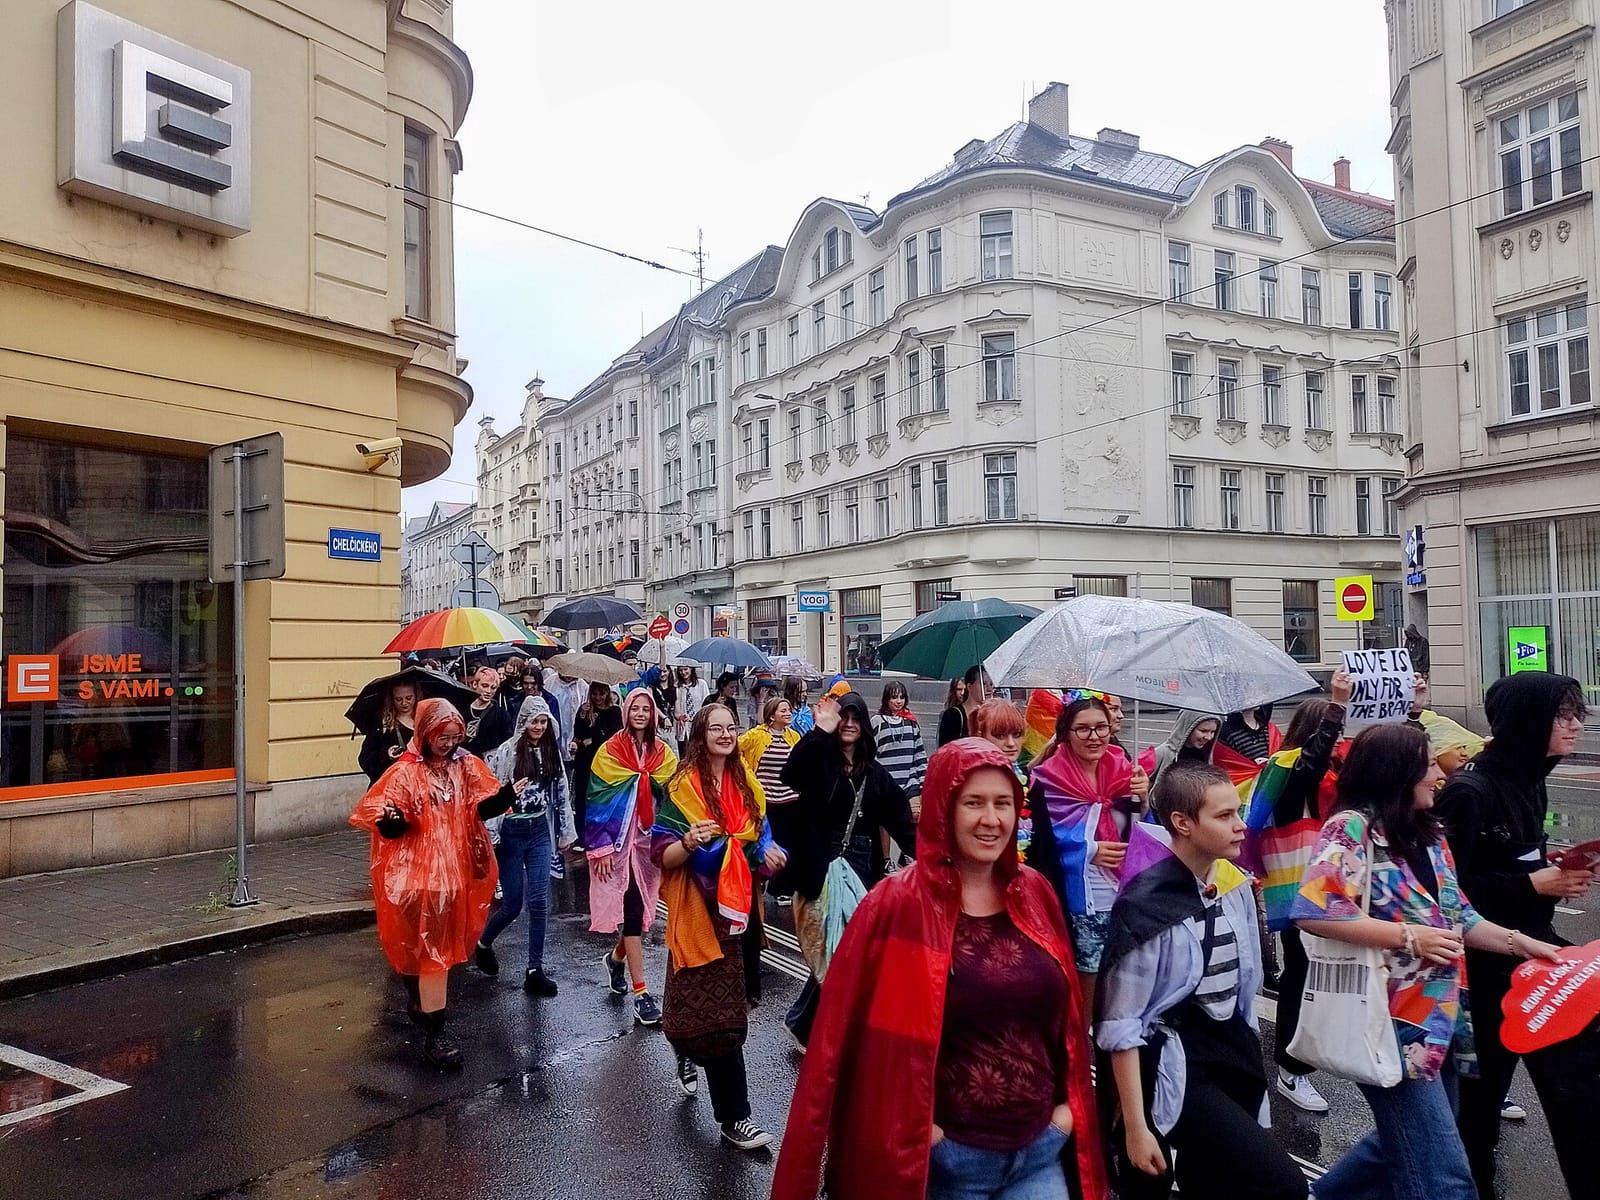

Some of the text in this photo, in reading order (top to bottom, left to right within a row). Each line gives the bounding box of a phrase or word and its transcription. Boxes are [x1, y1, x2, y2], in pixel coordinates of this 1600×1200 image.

[332, 535, 378, 554] CHELČICKÉHO
[677, 606, 687, 615] 30
[79, 654, 142, 673] JSME
[1345, 650, 1408, 674] LOVE IS
[79, 675, 159, 699] S VÁMI
[1380, 677, 1403, 700] FOR
[1350, 703, 1376, 719] THE
[1520, 985, 1550, 1013] JEDNA
[1526, 1004, 1557, 1033] JEDNO
